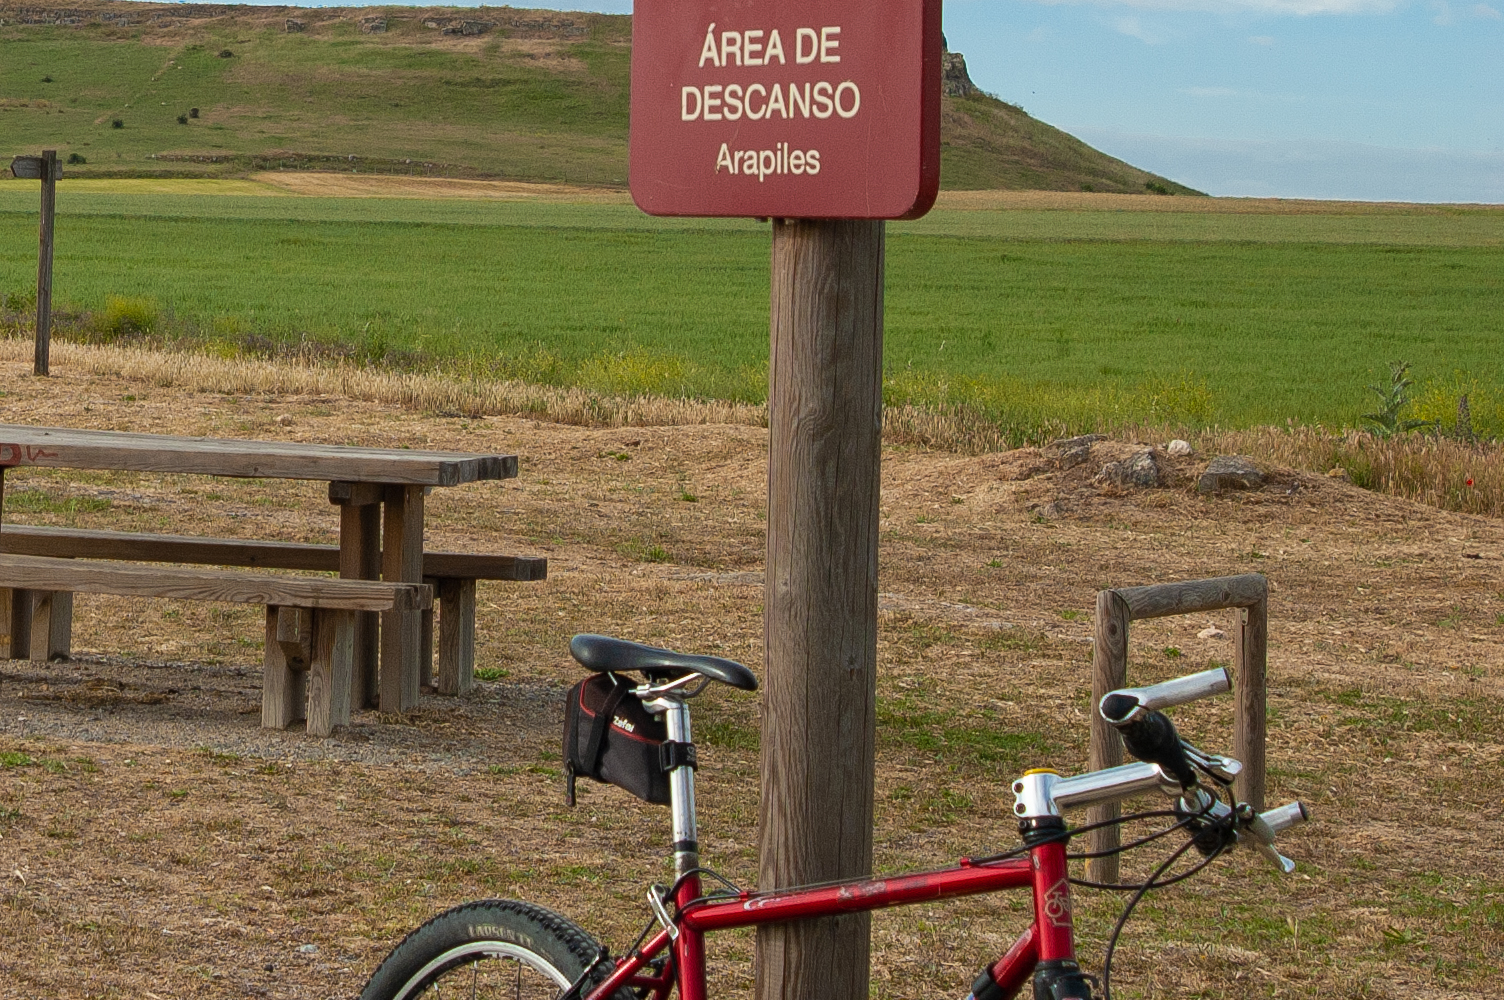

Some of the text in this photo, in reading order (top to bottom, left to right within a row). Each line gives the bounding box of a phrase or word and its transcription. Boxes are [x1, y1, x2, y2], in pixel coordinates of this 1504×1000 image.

[698, 22, 841, 68] ÁREA DE
[681, 81, 861, 122] DESCANSO
[716, 142, 821, 183] Arapiles
